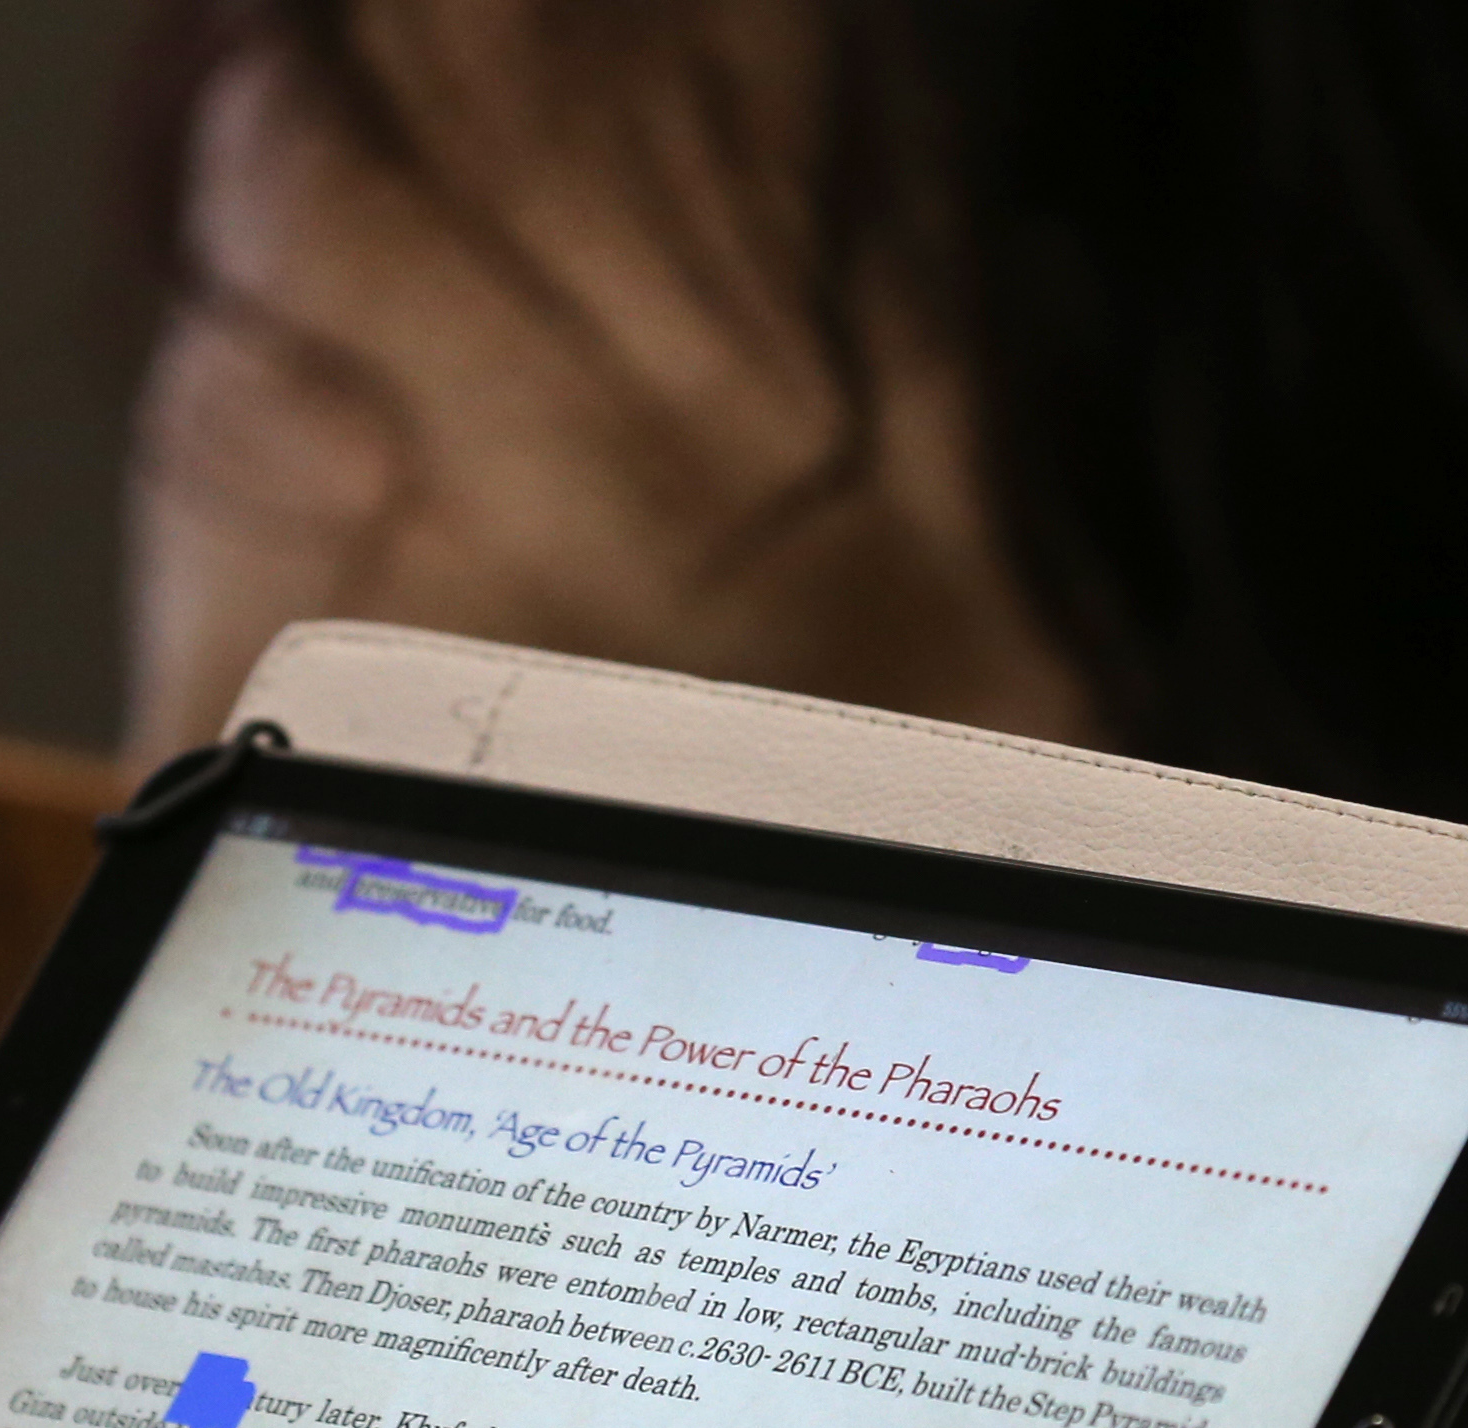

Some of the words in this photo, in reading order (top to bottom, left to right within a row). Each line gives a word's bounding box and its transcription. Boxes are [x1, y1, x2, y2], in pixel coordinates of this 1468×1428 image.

[511, 896, 551, 923] for
[554, 902, 614, 934] food.
[192, 1053, 253, 1097] The
[256, 1067, 334, 1109] Old
[326, 1083, 475, 1137] Kingdom,
[563, 1114, 620, 1153] of
[609, 1120, 666, 1164] the
[246, 951, 315, 1002] The
[318, 971, 485, 1029] Pyramids
[488, 998, 576, 1042] and
[568, 1003, 633, 1053] the
[637, 1024, 756, 1070] Power
[756, 1035, 819, 1079] of
[807, 1041, 872, 1091] the
[877, 1053, 1062, 1121] Pharaohs
[171, 1160, 245, 1196] build
[249, 1180, 388, 1220] impressive
[398, 1206, 551, 1246] monuments
[560, 1232, 622, 1259] such
[677, 1248, 781, 1284] temples
[790, 1269, 847, 1295] and
[854, 1278, 937, 1314] tombs,
[952, 1291, 1082, 1340] including
[1090, 1315, 1137, 1344] the
[1146, 1323, 1248, 1364] famous
[187, 1122, 251, 1156] Soon
[253, 1135, 320, 1166] after
[322, 1145, 366, 1174] the
[370, 1158, 507, 1197] unification
[511, 1177, 546, 1202] of
[542, 1181, 586, 1210] the
[589, 1196, 693, 1231] country
[694, 1204, 730, 1237] by
[729, 1211, 838, 1254] Narmer,
[846, 1231, 891, 1260] the
[894, 1237, 1031, 1283] Egyptians
[1036, 1268, 1103, 1295] used
[1103, 1273, 1172, 1307] their
[1177, 1292, 1267, 1324] wealth
[58, 1354, 119, 1386] Just
[124, 1373, 184, 1397] over
[91, 1236, 173, 1268] called
[169, 1253, 291, 1289] mastabas.
[299, 1267, 364, 1302] Then
[364, 1278, 453, 1319] Djoser,
[452, 1296, 565, 1335] pharaoh
[566, 1312, 675, 1354] between
[837, 1358, 906, 1395] BCE,
[910, 1369, 975, 1405] built
[977, 1383, 1022, 1412] the
[1022, 1391, 1086, 1428] Step
[101, 1276, 178, 1312] house
[181, 1289, 223, 1320] his
[225, 1306, 299, 1332] spirit
[301, 1318, 368, 1344] more
[371, 1330, 551, 1379] magnificently
[551, 1355, 619, 1386] after
[621, 1365, 700, 1401] death.
[108, 1200, 235, 1237] pyramids.
[251, 1215, 299, 1247] The
[304, 1226, 361, 1257] first
[362, 1237, 488, 1278] pharaohs
[497, 1264, 558, 1290] were
[564, 1276, 697, 1312] entombed
[732, 1296, 784, 1331] low,
[792, 1314, 951, 1355] rectangular
[954, 1341, 1094, 1381] mud-brick
[1100, 1357, 1225, 1405] buildings
[8, 1388, 67, 1421] Giza
